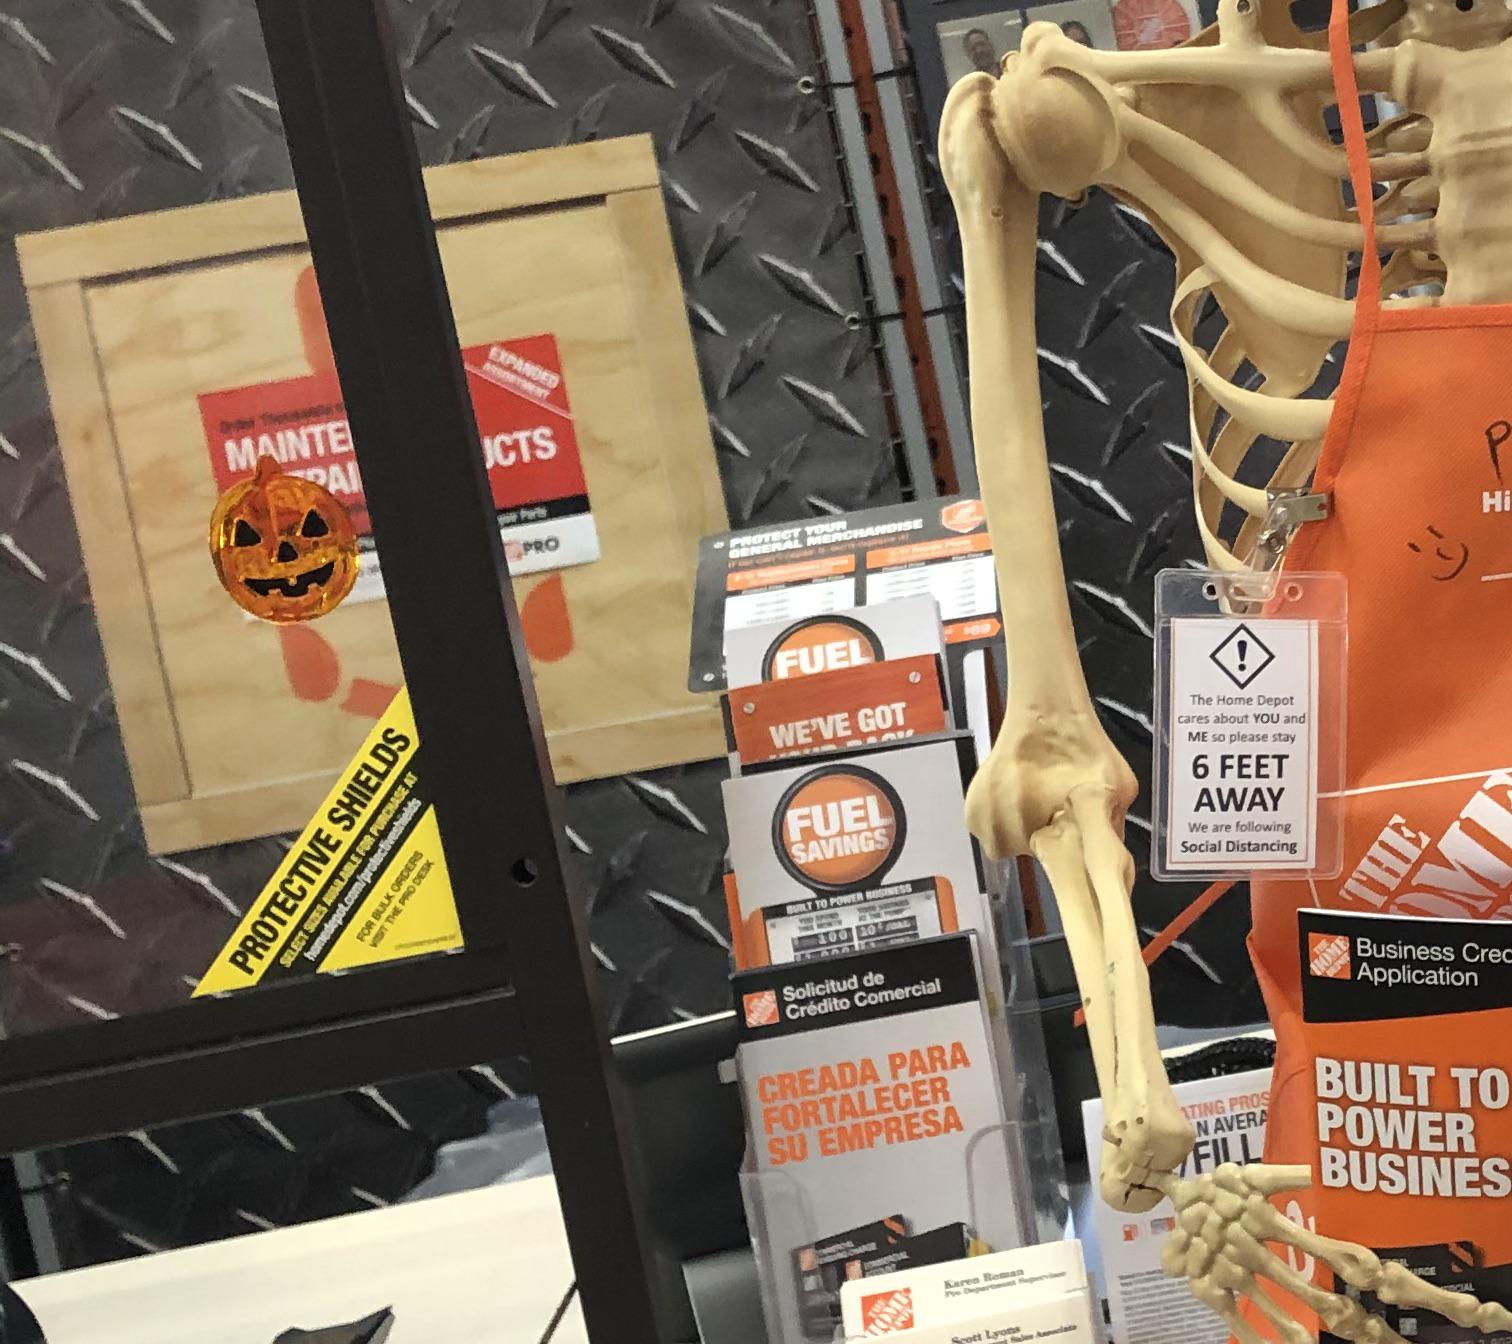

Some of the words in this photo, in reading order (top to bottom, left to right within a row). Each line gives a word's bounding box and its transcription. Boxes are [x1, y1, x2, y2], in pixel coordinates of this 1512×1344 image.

[488, 345, 560, 390] EXPANDED
[523, 537, 560, 557] PRO
[728, 539, 805, 560] GENERAL
[806, 518, 924, 549] MERCHANDISE
[729, 526, 801, 549] PROTECT
[804, 519, 848, 537] YOUR
[775, 638, 873, 680] FUEL
[1177, 714, 1210, 725] cares
[1213, 712, 1249, 725] about
[1253, 713, 1280, 725] YOU
[1283, 712, 1306, 725] and
[1190, 694, 1213, 706] The
[1216, 694, 1253, 706] Home
[1257, 694, 1295, 709] Depot
[768, 711, 853, 750] WE'VE
[857, 701, 908, 732] GOT
[1187, 731, 1208, 743] ME
[1211, 734, 1226, 743] so
[1229, 730, 1268, 746] please
[1272, 731, 1297, 746] stay
[1191, 754, 1209, 780] 6
[1220, 754, 1290, 780] FEET
[784, 794, 894, 842] FUEL
[1193, 787, 1285, 813] AWAY
[790, 827, 892, 865] SAVINGS
[1188, 821, 1209, 833] We
[1211, 823, 1232, 833] are
[1235, 820, 1292, 836] following
[228, 826, 344, 977] PROTECTIVE
[326, 727, 411, 833] SHIELDS
[1180, 840, 1222, 853] Social
[1225, 840, 1298, 856] Distancing
[1339, 813, 1432, 909] THE
[356, 921, 374, 944] FOR
[371, 892, 395, 924] BULK
[391, 850, 425, 893] ORDERS
[369, 921, 388, 948] VISIT
[385, 899, 402, 925] THE
[398, 878, 417, 905] PRO
[413, 859, 436, 885] DESK
[785, 899, 814, 916] BUILT
[815, 897, 829, 911] TO
[829, 890, 864, 910] POWER
[865, 881, 914, 906] BUSINESS
[1356, 937, 1455, 962] Business
[782, 973, 859, 1003] Solicitud
[862, 971, 886, 987] de
[1356, 963, 1479, 987] Application
[785, 995, 851, 1022] Crédito
[854, 978, 943, 1007] Comercial
[757, 1057, 881, 1105] CREADA
[887, 1040, 972, 1082] PARA
[1315, 1056, 1436, 1107] BUILT
[1450, 1066, 1510, 1110] TO
[761, 1074, 951, 1136] FORTALECER
[766, 1133, 810, 1167] SU
[816, 1105, 965, 1157] EMPRESA
[1317, 1102, 1477, 1153] POWER
[944, 1272, 981, 1289] Karen
[985, 1324, 1022, 1342] Lyons
